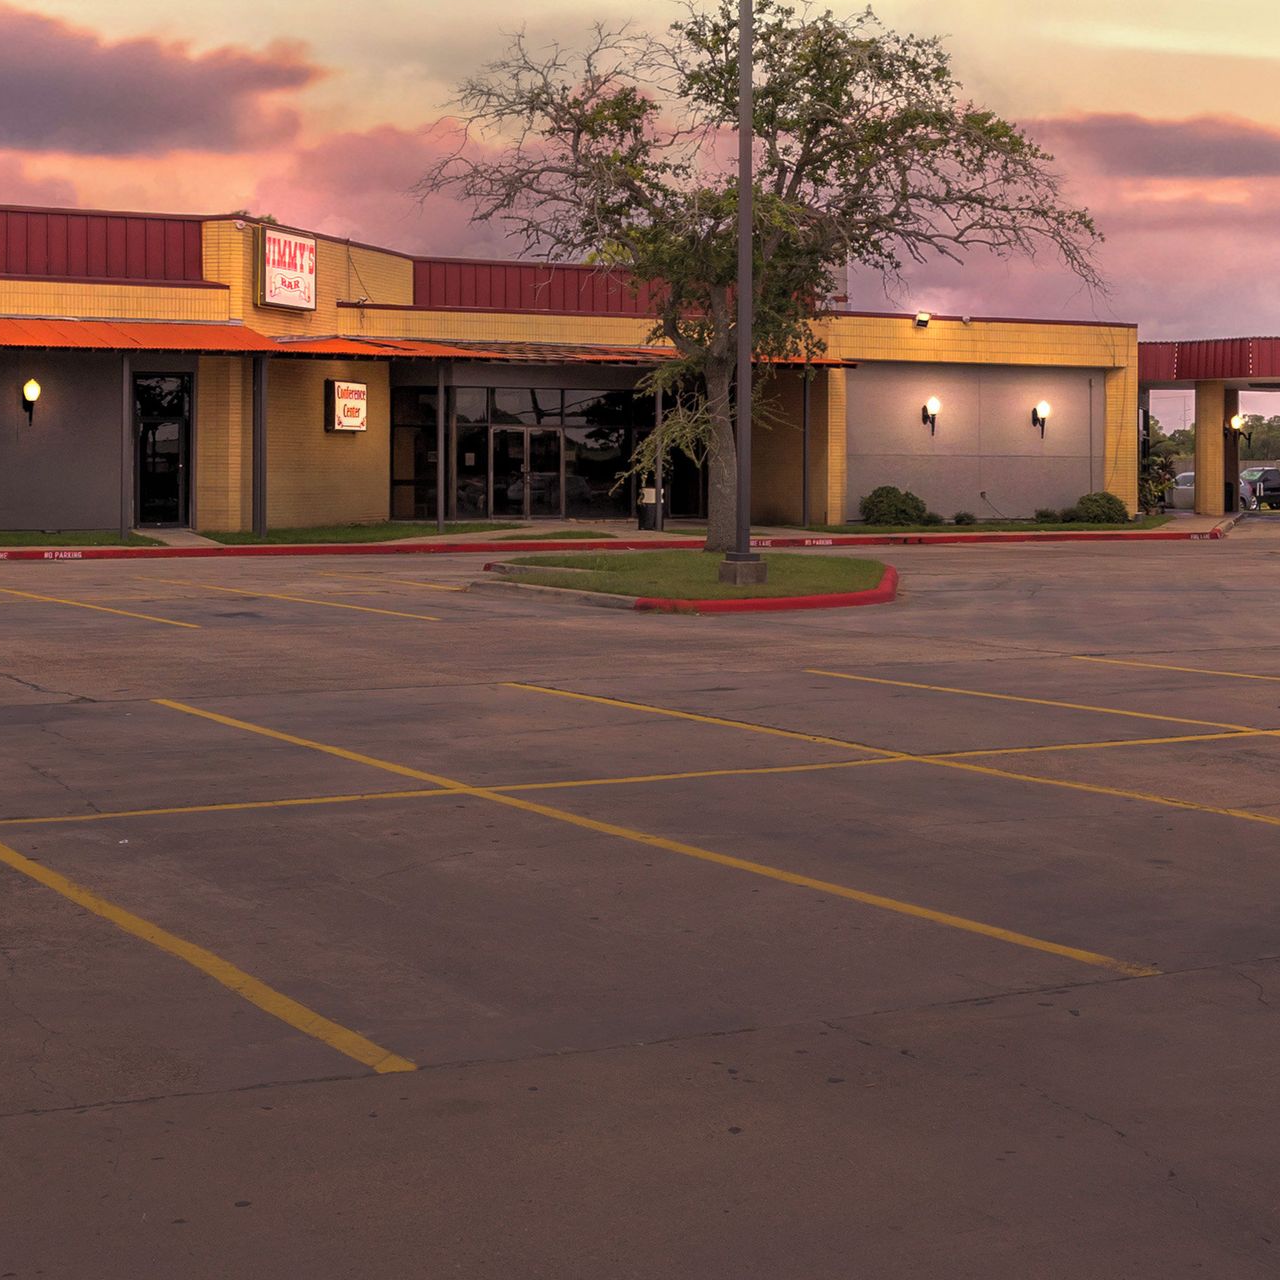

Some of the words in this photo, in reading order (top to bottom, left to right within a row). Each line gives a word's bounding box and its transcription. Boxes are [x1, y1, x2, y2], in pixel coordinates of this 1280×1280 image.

[266, 236, 316, 275] JIMMY'S
[280, 277, 301, 290] BAR
[337, 385, 367, 401] Conference
[343, 403, 361, 418] Center
[43, 551, 54, 560] NO
[54, 551, 83, 560] PARKING
